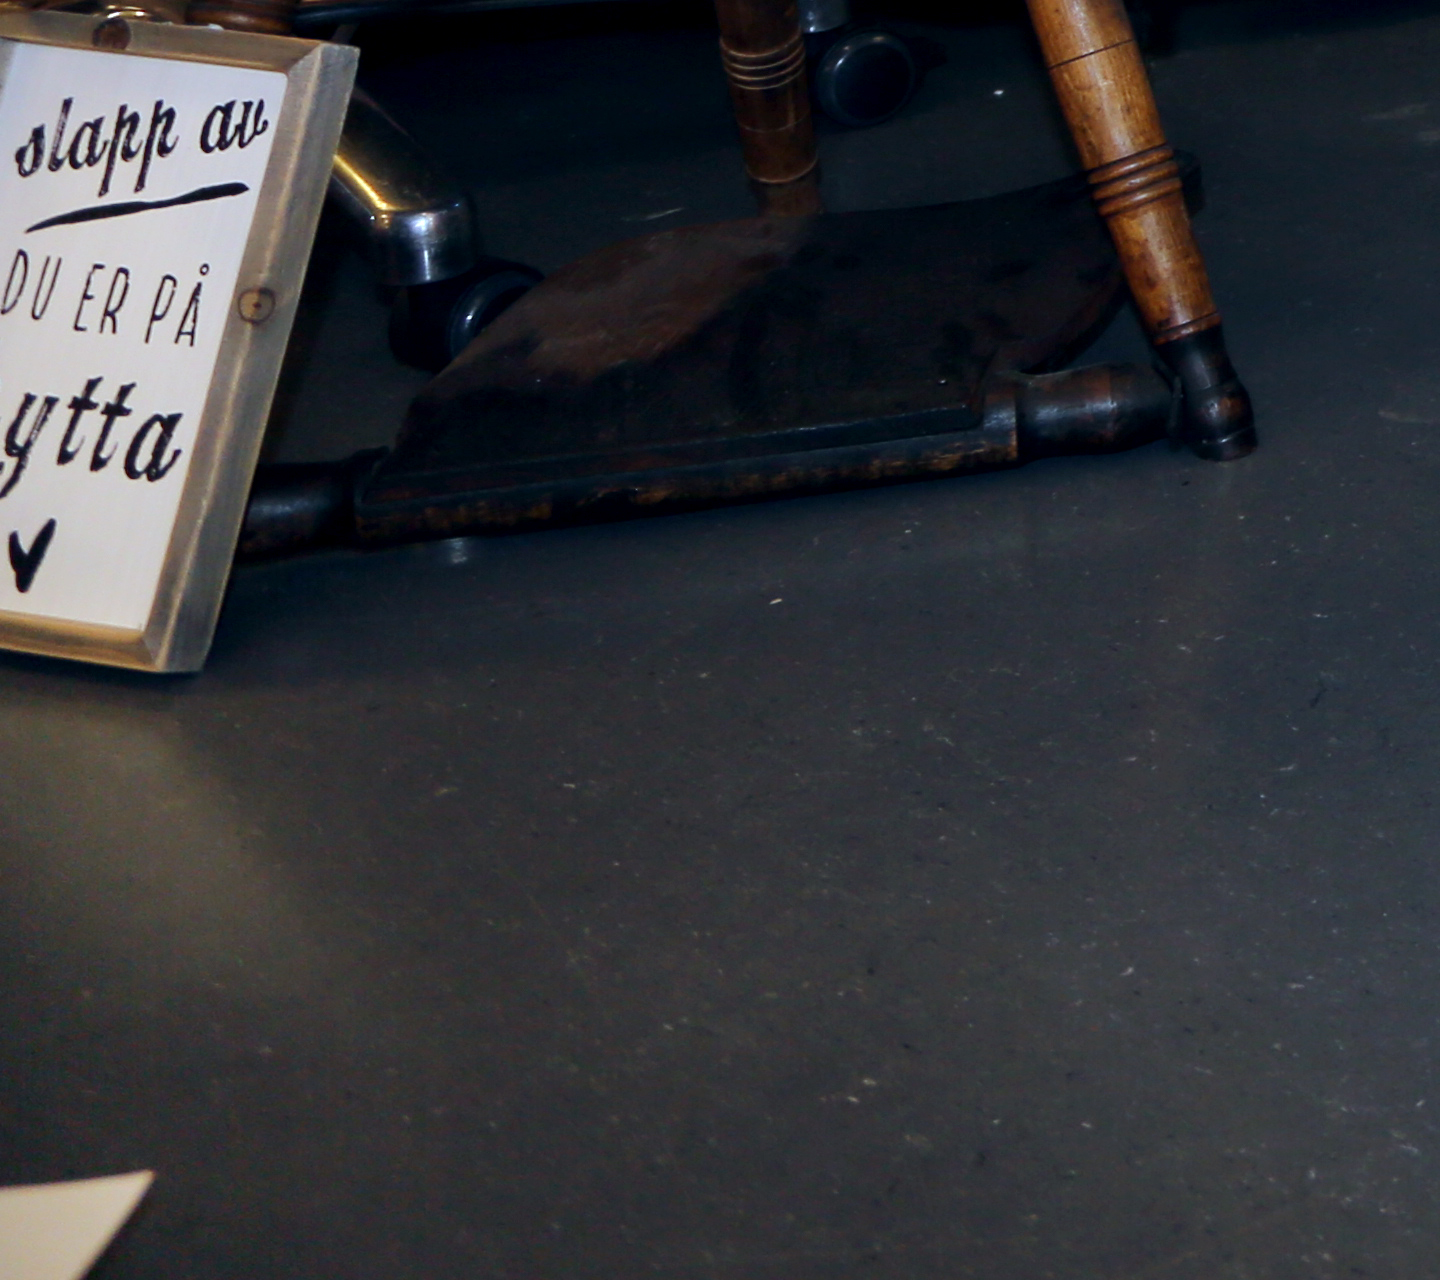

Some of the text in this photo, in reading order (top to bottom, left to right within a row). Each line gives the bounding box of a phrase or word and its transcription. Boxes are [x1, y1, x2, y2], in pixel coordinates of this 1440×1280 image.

[15, 96, 269, 198] slapp av
[0, 248, 210, 347] DU ER PÅ
[0, 375, 184, 500] ytta
